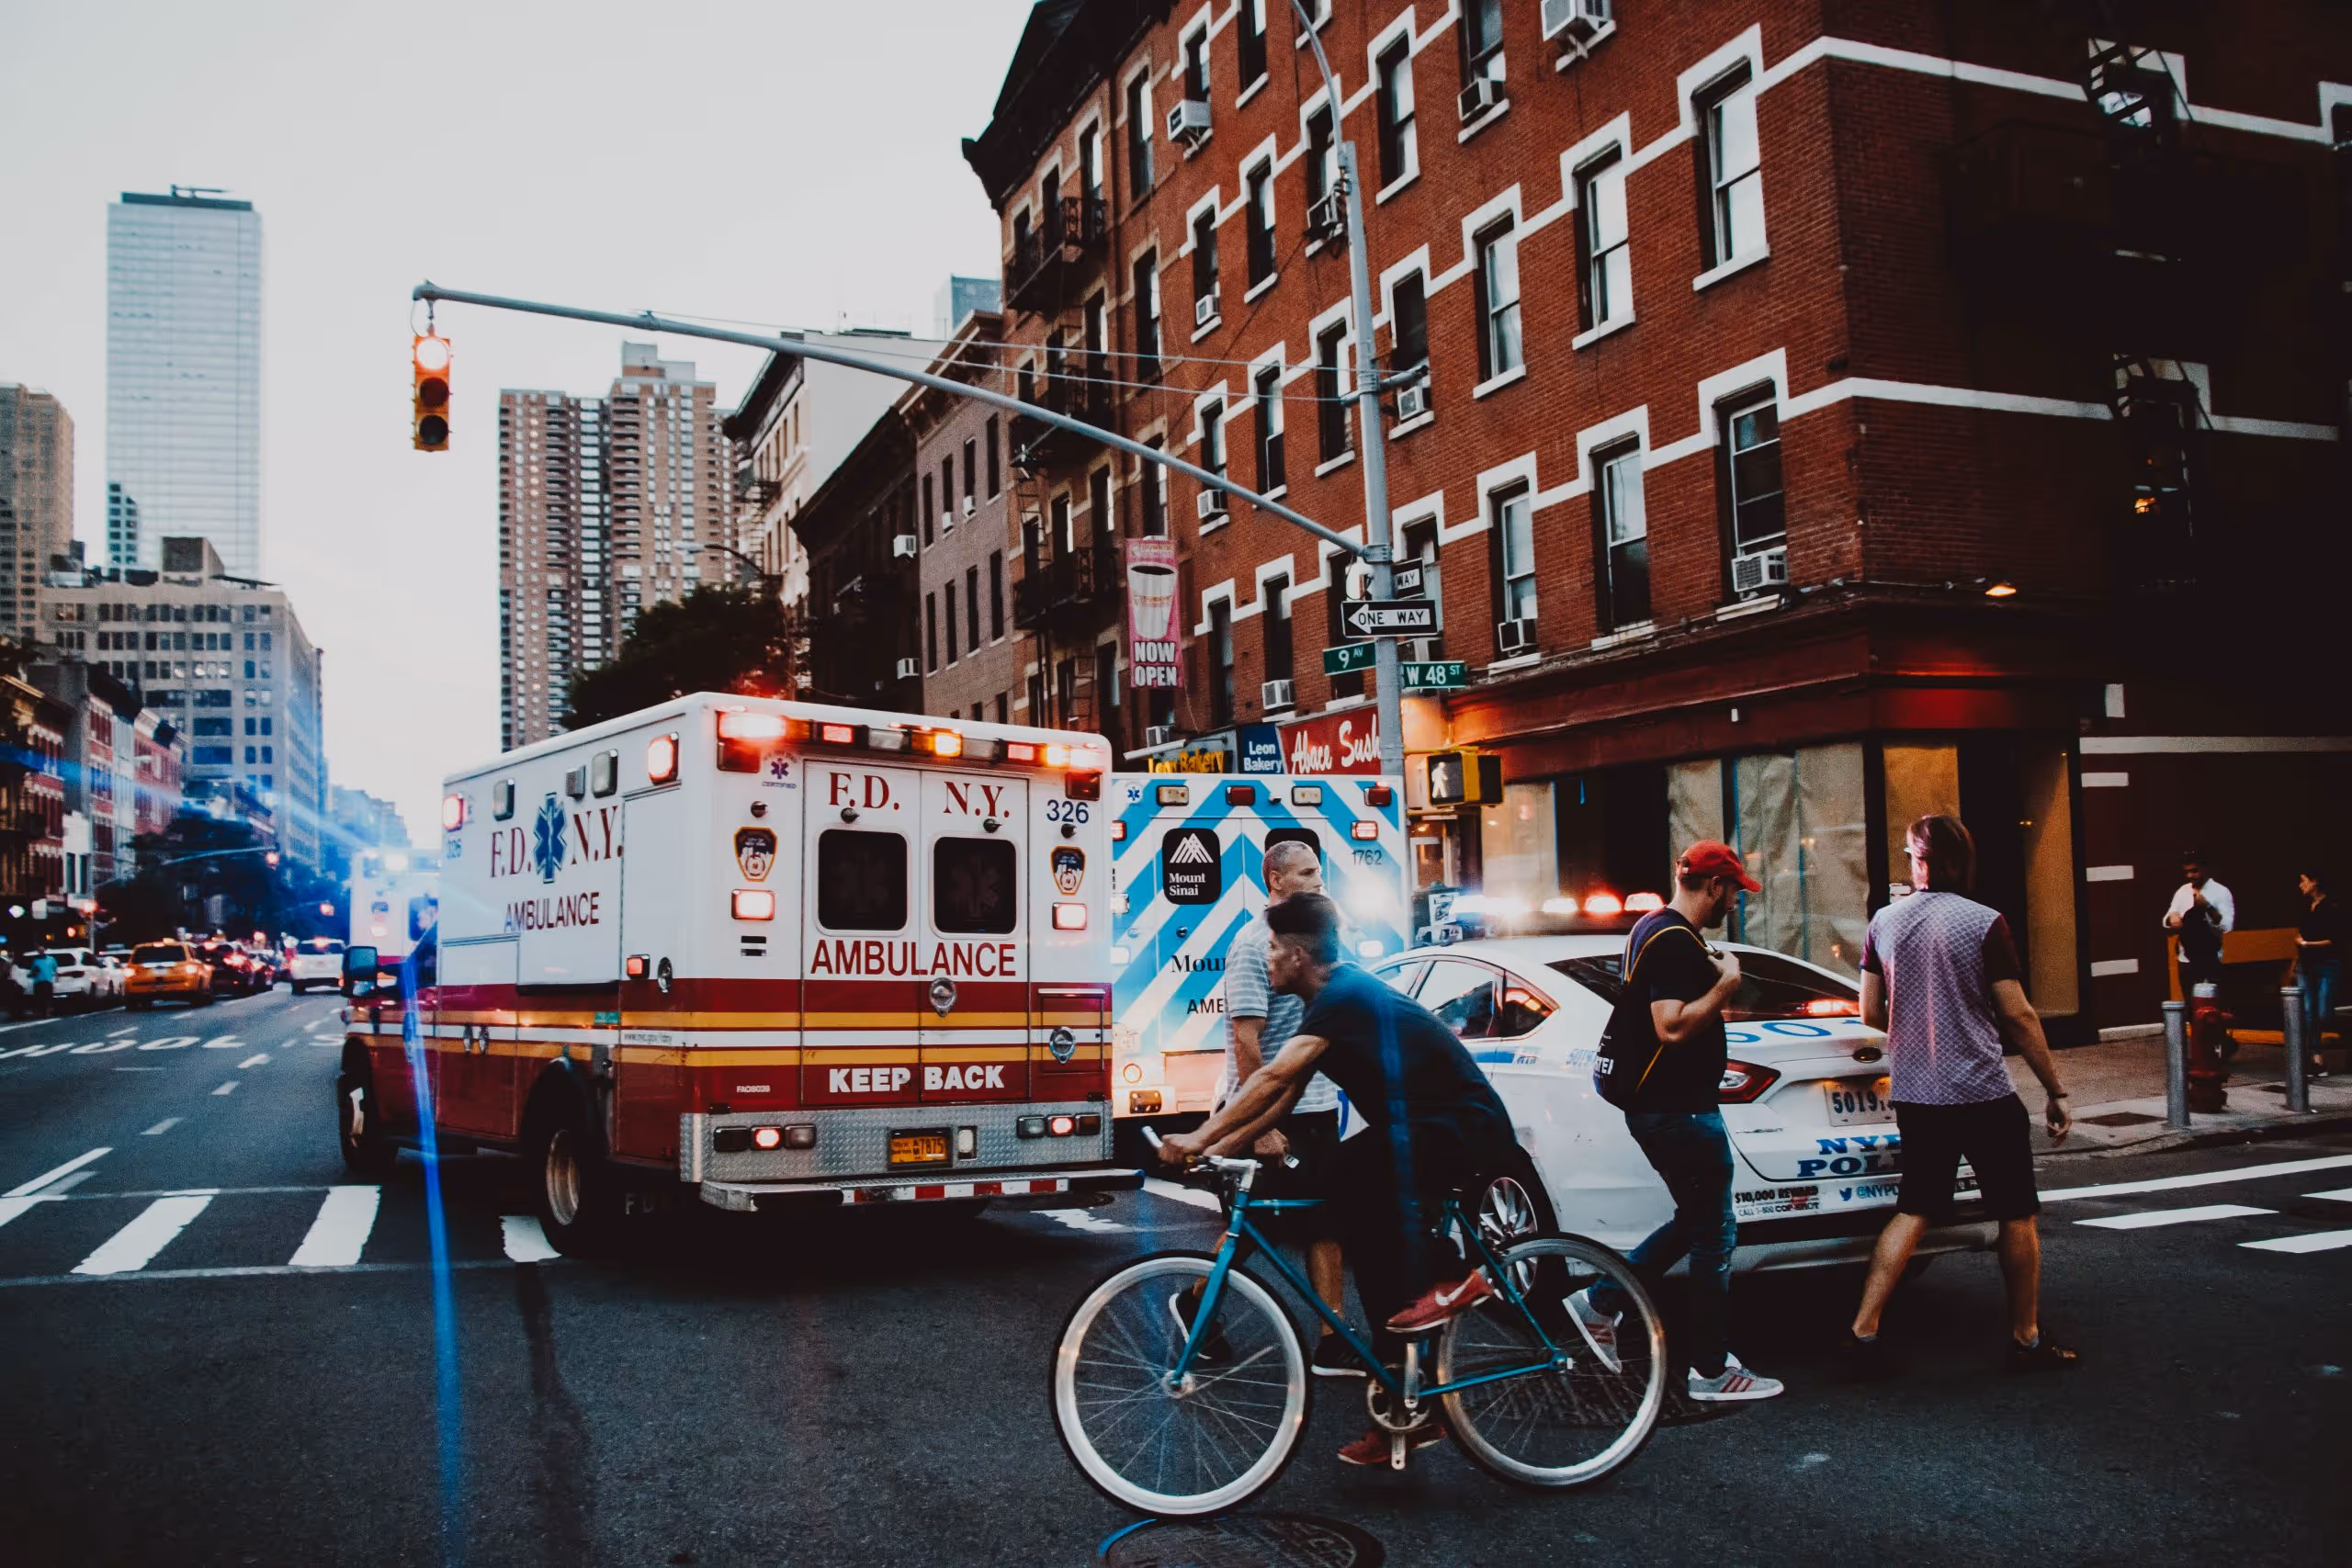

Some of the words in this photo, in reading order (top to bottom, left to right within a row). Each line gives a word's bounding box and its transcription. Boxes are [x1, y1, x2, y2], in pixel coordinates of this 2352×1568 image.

[1358, 612, 1385, 626] ONE
[1396, 611, 1424, 624] WAY
[1134, 641, 1175, 662] NOW
[1338, 649, 1350, 669] 9
[1352, 647, 1363, 659] AV
[1135, 665, 1177, 686] OPEN
[1406, 666, 1419, 685] W
[1425, 665, 1446, 685] 48
[1449, 665, 1461, 675] ST
[1249, 740, 1275, 755] Leon
[1339, 714, 1381, 767] Sush
[1243, 757, 1284, 773] Bakery
[829, 772, 899, 810] F.D.
[943, 781, 1010, 818] N.Y.
[1046, 800, 1090, 825] 326
[1351, 849, 1382, 865] 1762
[1169, 873, 1206, 883] Mount
[1169, 885, 1199, 897] Sinai
[504, 892, 600, 932] AMBULANCE
[810, 940, 1016, 977] AMBULANCE
[829, 1067, 911, 1093] KEEP
[924, 1065, 1005, 1091] BACK
[1815, 1134, 1902, 1156] NYP
[1735, 1190, 1776, 1204] $10,000
[1738, 1208, 1755, 1217] CALL
